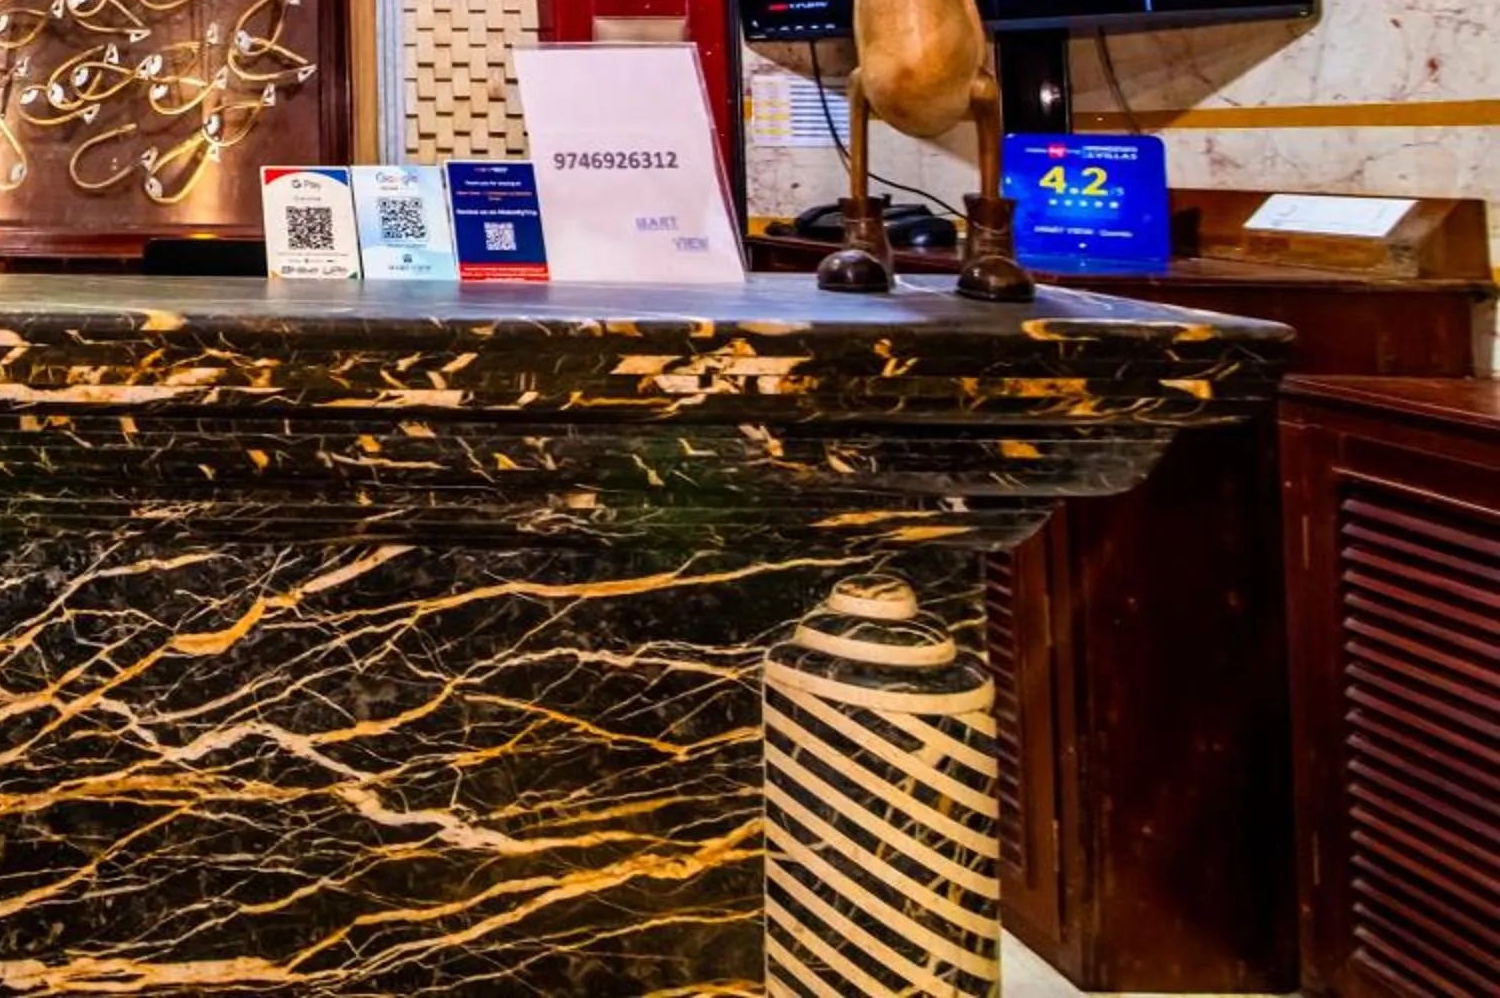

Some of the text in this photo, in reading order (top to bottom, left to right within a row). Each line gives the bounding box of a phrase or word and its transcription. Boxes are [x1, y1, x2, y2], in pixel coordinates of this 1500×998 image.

[553, 152, 679, 170] 9746926312
[304, 179, 322, 191] Pay
[375, 172, 419, 187] Google
[1039, 166, 1108, 196] 4.2
